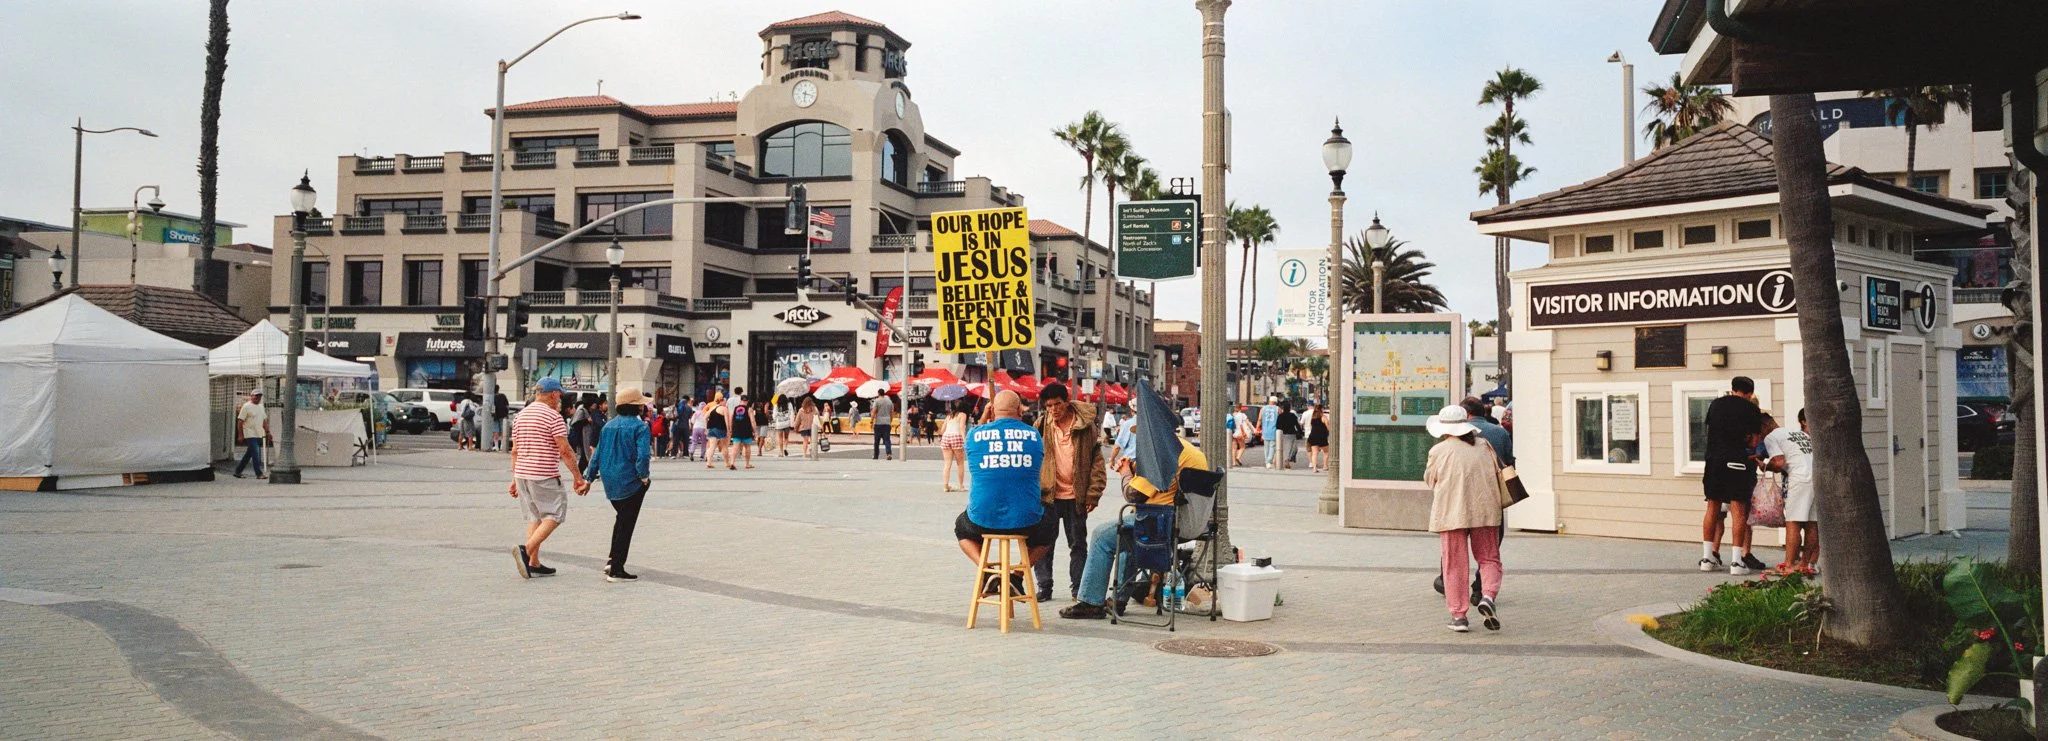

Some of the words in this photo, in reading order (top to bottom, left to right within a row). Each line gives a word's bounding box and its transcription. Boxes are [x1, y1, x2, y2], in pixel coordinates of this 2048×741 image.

[937, 215, 972, 234] OUR
[978, 211, 1024, 231] HOPE
[169, 230, 200, 242] Shoreb
[962, 233, 978, 250] IS
[984, 231, 1001, 249] IN
[938, 247, 1028, 282] JESUS
[942, 281, 1011, 303] BELIEVE
[1016, 280, 1027, 298] &
[1317, 259, 1326, 326] INFORMATION
[1533, 294, 1603, 315] VISITOR
[1608, 284, 1753, 311] INFORMATION
[942, 300, 1007, 321] REPENT
[1012, 298, 1029, 316] IN
[1308, 290, 1316, 326] VISITOR
[541, 315, 581, 330] Hurley
[943, 316, 1032, 350] JESUS
[426, 338, 465, 348] futures.
[780, 352, 844, 364] VOLCOM
[974, 429, 1000, 442] OUR
[1004, 429, 1037, 441] HOPE
[989, 441, 1003, 452] IS
[1007, 441, 1023, 452] IN
[979, 454, 1032, 469] JESUS
